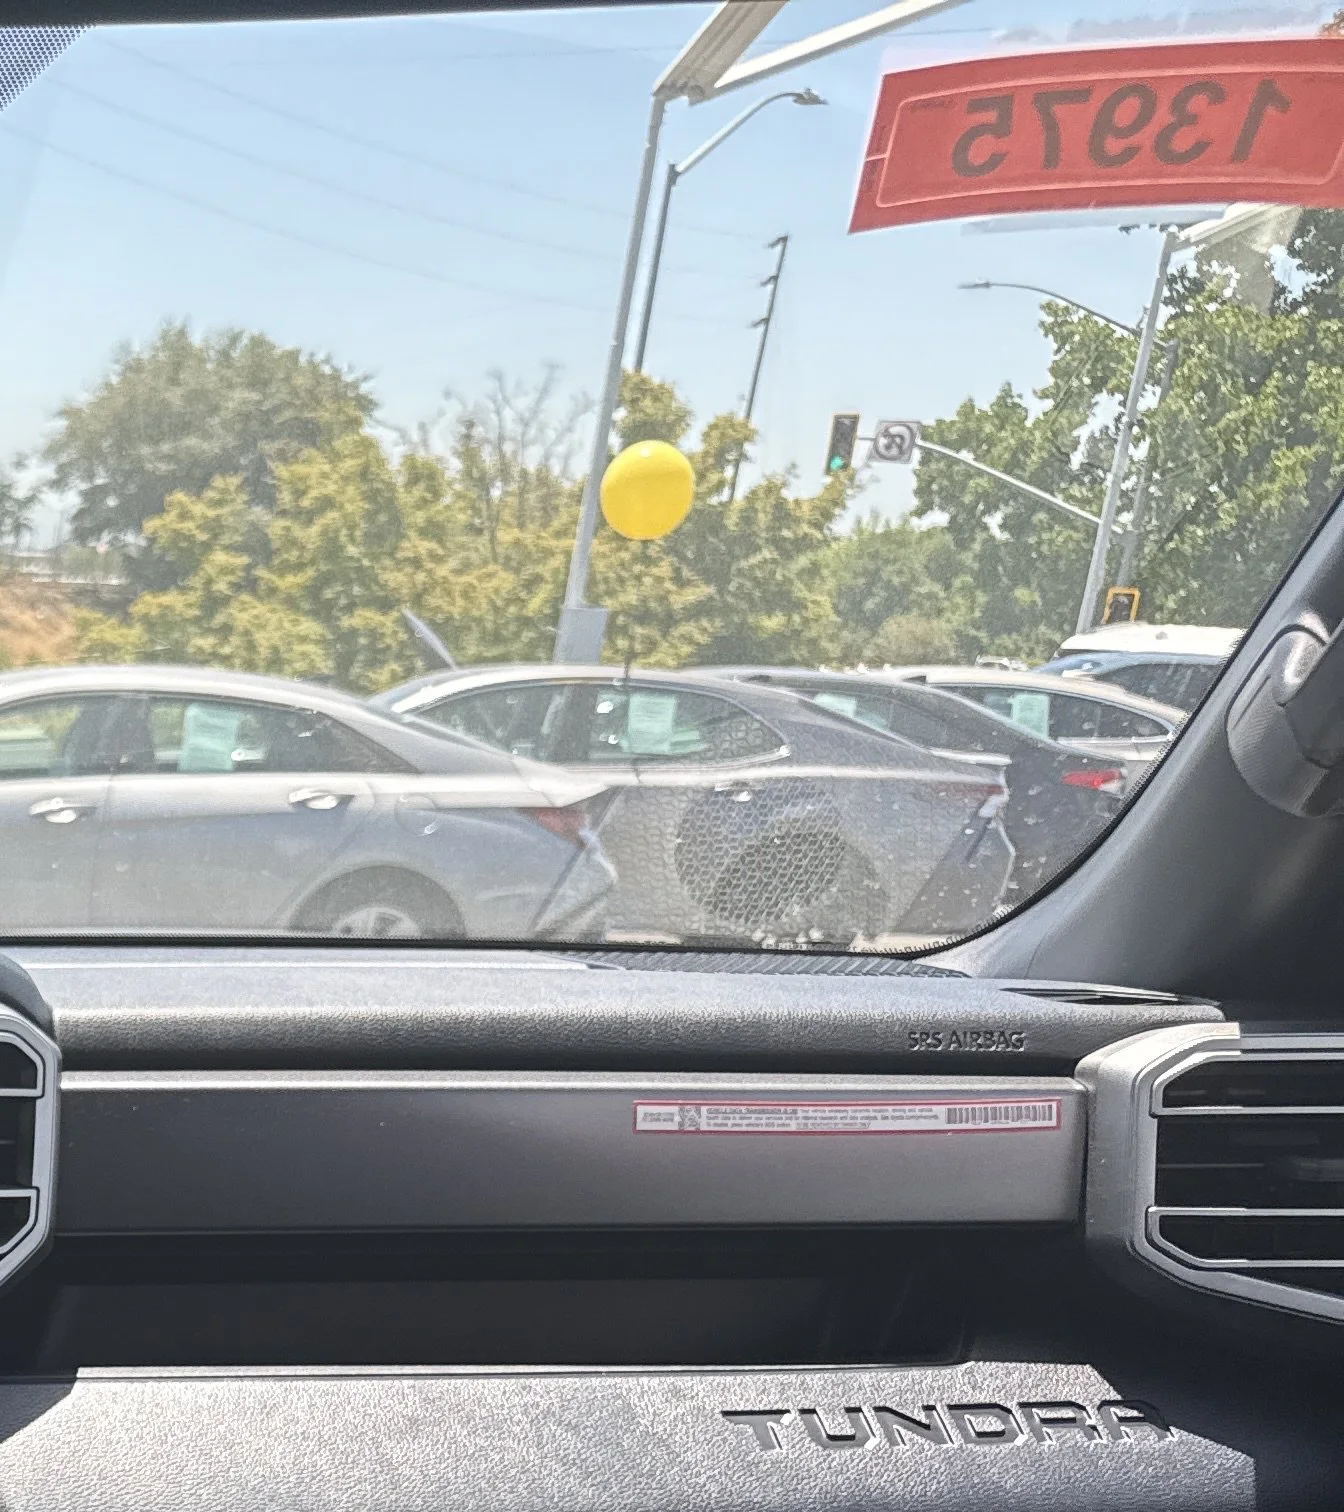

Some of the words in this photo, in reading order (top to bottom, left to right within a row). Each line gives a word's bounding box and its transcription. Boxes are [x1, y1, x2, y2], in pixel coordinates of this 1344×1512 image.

[908, 1031, 944, 1051] SRS
[948, 1030, 1025, 1051] AIRBAG
[720, 1400, 1178, 1453] TUNDRA
